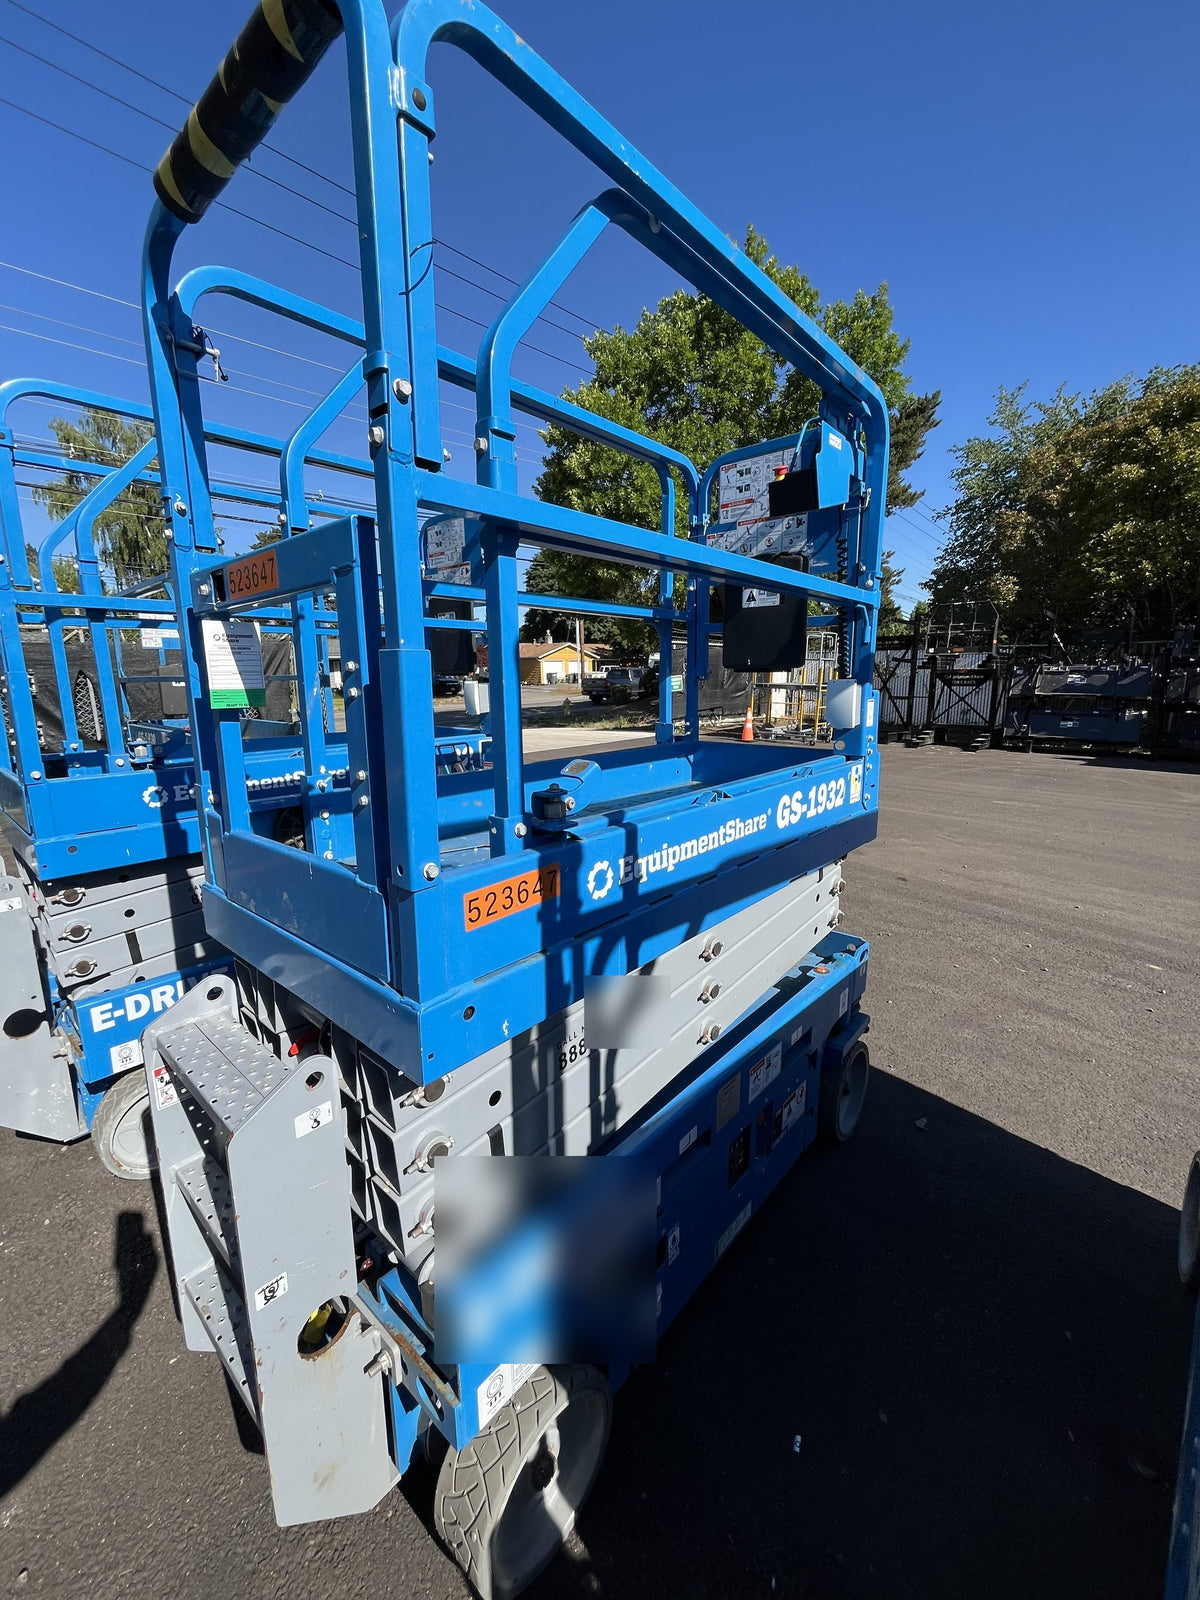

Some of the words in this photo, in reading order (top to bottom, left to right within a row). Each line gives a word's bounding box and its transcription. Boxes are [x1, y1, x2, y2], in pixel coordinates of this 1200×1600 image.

[229, 557, 275, 594] 523647
[618, 811, 768, 886] EquipmentShare
[776, 777, 846, 829] GS-1932
[467, 869, 558, 924] 523647
